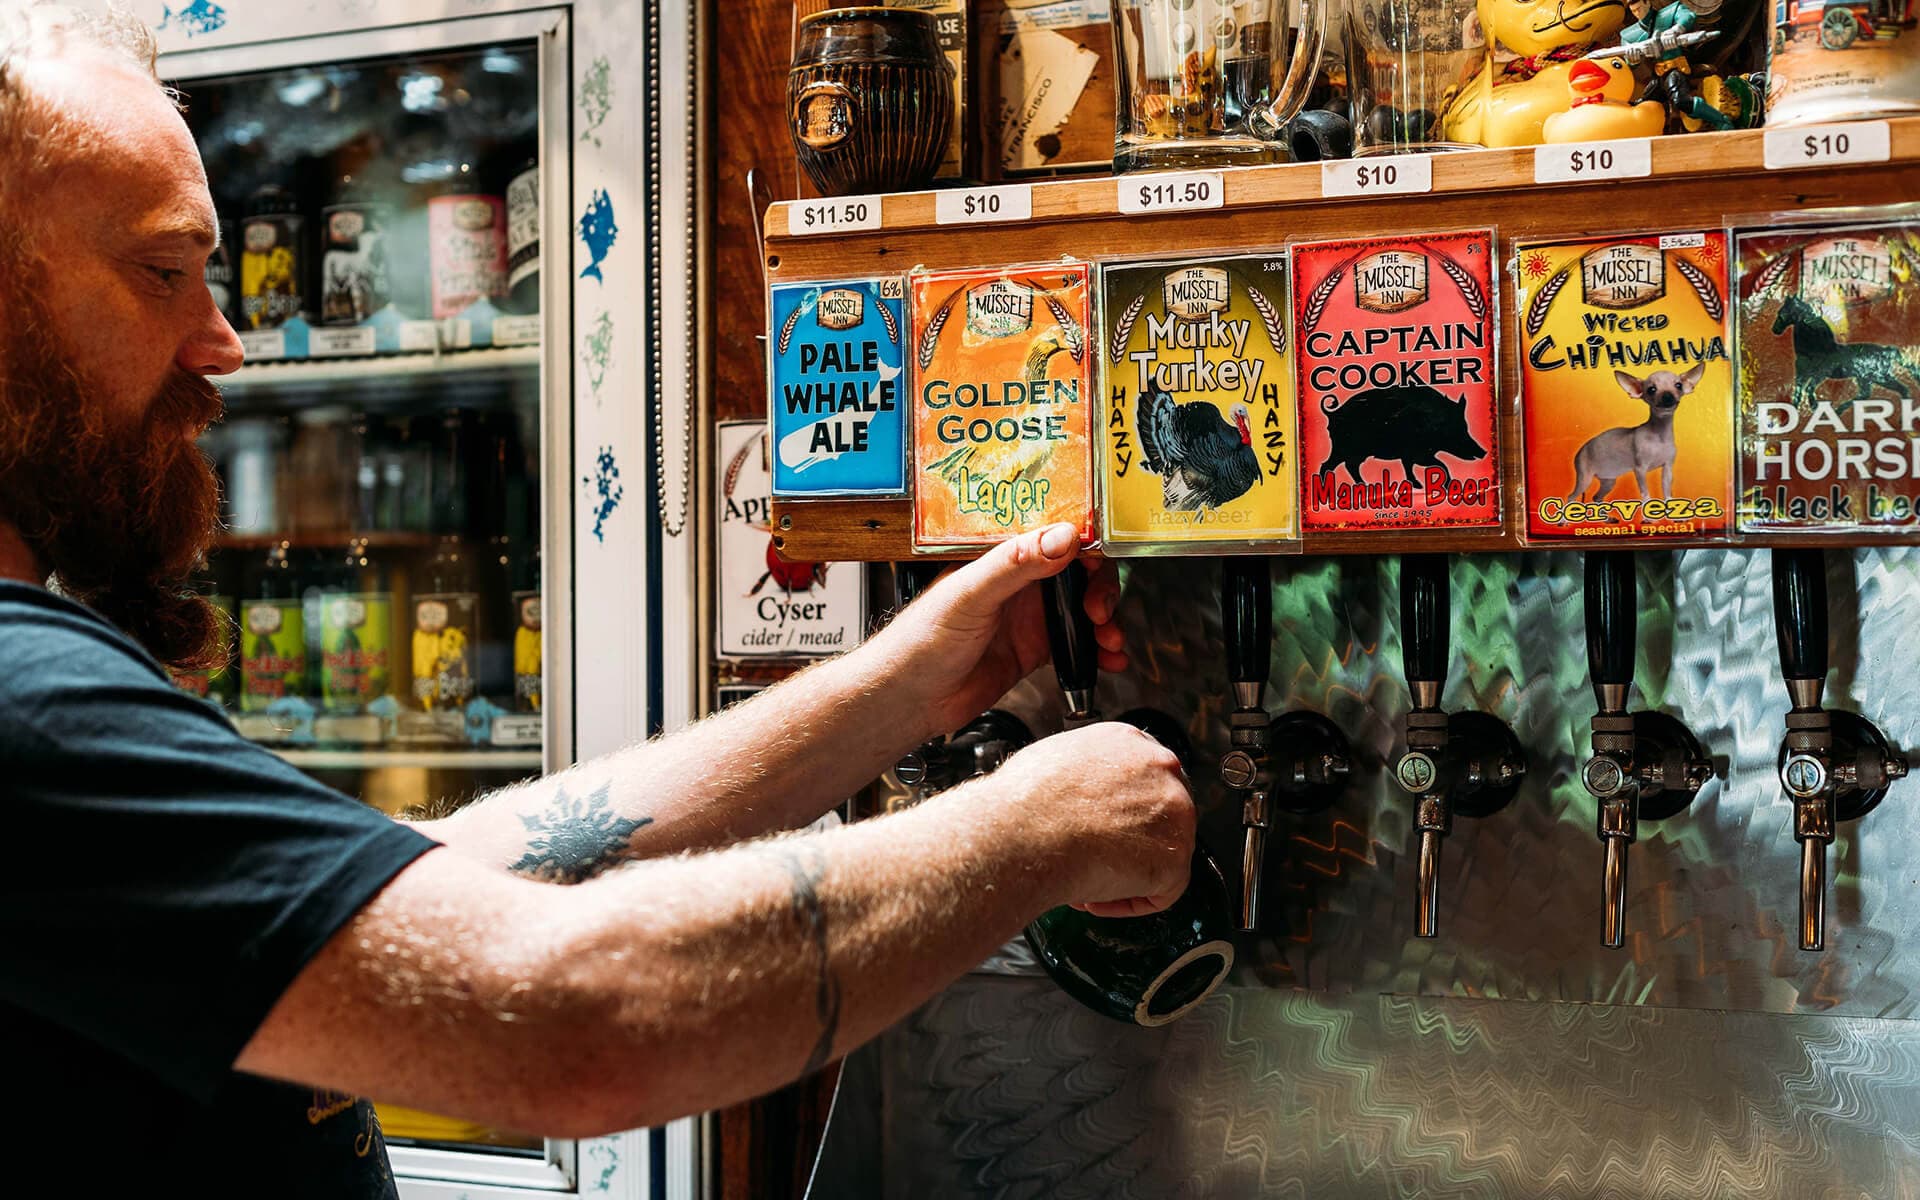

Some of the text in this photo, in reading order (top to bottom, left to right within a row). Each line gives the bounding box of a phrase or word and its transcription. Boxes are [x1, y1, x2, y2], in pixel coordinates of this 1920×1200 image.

[1008, 78, 1052, 154] FRANCISCO
[1804, 134, 1849, 157] $10
[1570, 149, 1613, 172] $10
[1356, 165, 1397, 187] $10
[964, 195, 1000, 215] $10
[1139, 182, 1210, 207] $11.50
[804, 204, 867, 226] $11.50
[1467, 244, 1482, 255] 5%
[1610, 247, 1632, 258] THE
[1833, 241, 1857, 252] THE
[1263, 262, 1283, 272] 5.8%
[1379, 254, 1400, 264] THE
[1811, 254, 1884, 286] MUSSEL
[1185, 270, 1204, 278] THE
[1364, 265, 1422, 294] MUSSEL
[1592, 260, 1657, 290] MUSSEL
[882, 280, 901, 297] 6%
[991, 284, 1008, 292] THE
[1171, 280, 1224, 305] MUSSEL
[1381, 290, 1404, 304] INN
[1611, 286, 1638, 300] INN
[822, 299, 859, 317] MUSSEL
[976, 294, 1027, 318] MUSSEL
[1187, 302, 1208, 314] INN
[833, 316, 848, 325] INN
[1145, 310, 1251, 358] Murky
[1306, 321, 1484, 360] CAPTAIN
[800, 341, 878, 374] PALE
[1129, 350, 1265, 404] Turkey
[1309, 357, 1483, 392] COOKER
[783, 381, 895, 414] WHALE
[923, 378, 1079, 409] GOLDEN
[809, 421, 868, 454] ALE
[937, 415, 1067, 444] GOOSE
[1109, 385, 1132, 478] HAZY
[1262, 383, 1286, 476] HAZY
[958, 466, 1050, 527] Lager
[1311, 466, 1490, 512] Manuka Beer
[1539, 497, 1724, 524] Cerveza
[1752, 484, 1851, 519] black
[1149, 507, 1254, 529] hazy beer
[1374, 510, 1433, 520] since 1995
[1574, 523, 1695, 536] seasonal special
[757, 596, 827, 628] Cyser
[741, 628, 783, 646] cider
[799, 626, 845, 646] mead
